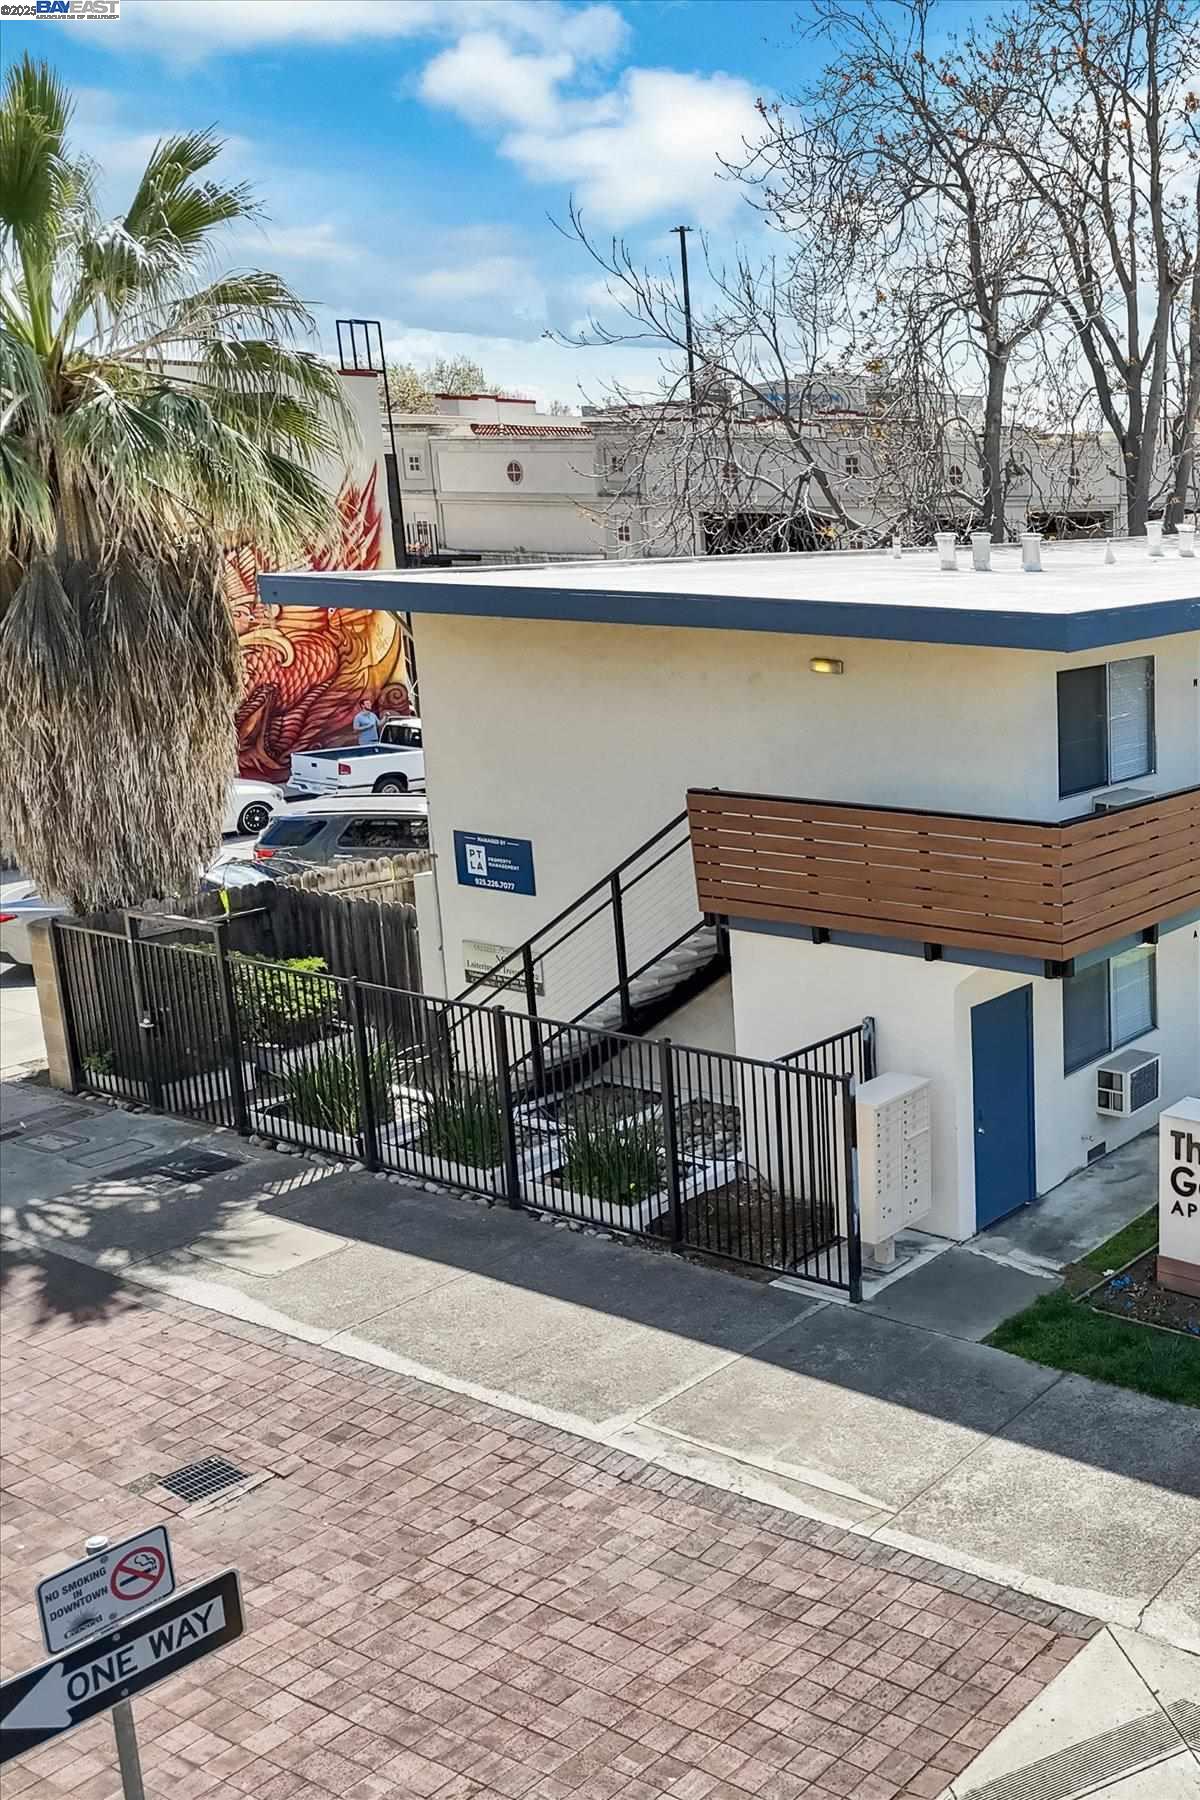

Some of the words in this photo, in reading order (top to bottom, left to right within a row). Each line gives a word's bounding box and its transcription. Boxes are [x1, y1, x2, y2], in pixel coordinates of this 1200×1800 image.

[44, 1590, 60, 1604] NO
[61, 1566, 106, 1596] SMOKING
[49, 1585, 108, 1622] DOWNTOWN
[72, 1588, 83, 1600] IN
[66, 1645, 138, 1702] ONE
[149, 1603, 214, 1660] WAY
